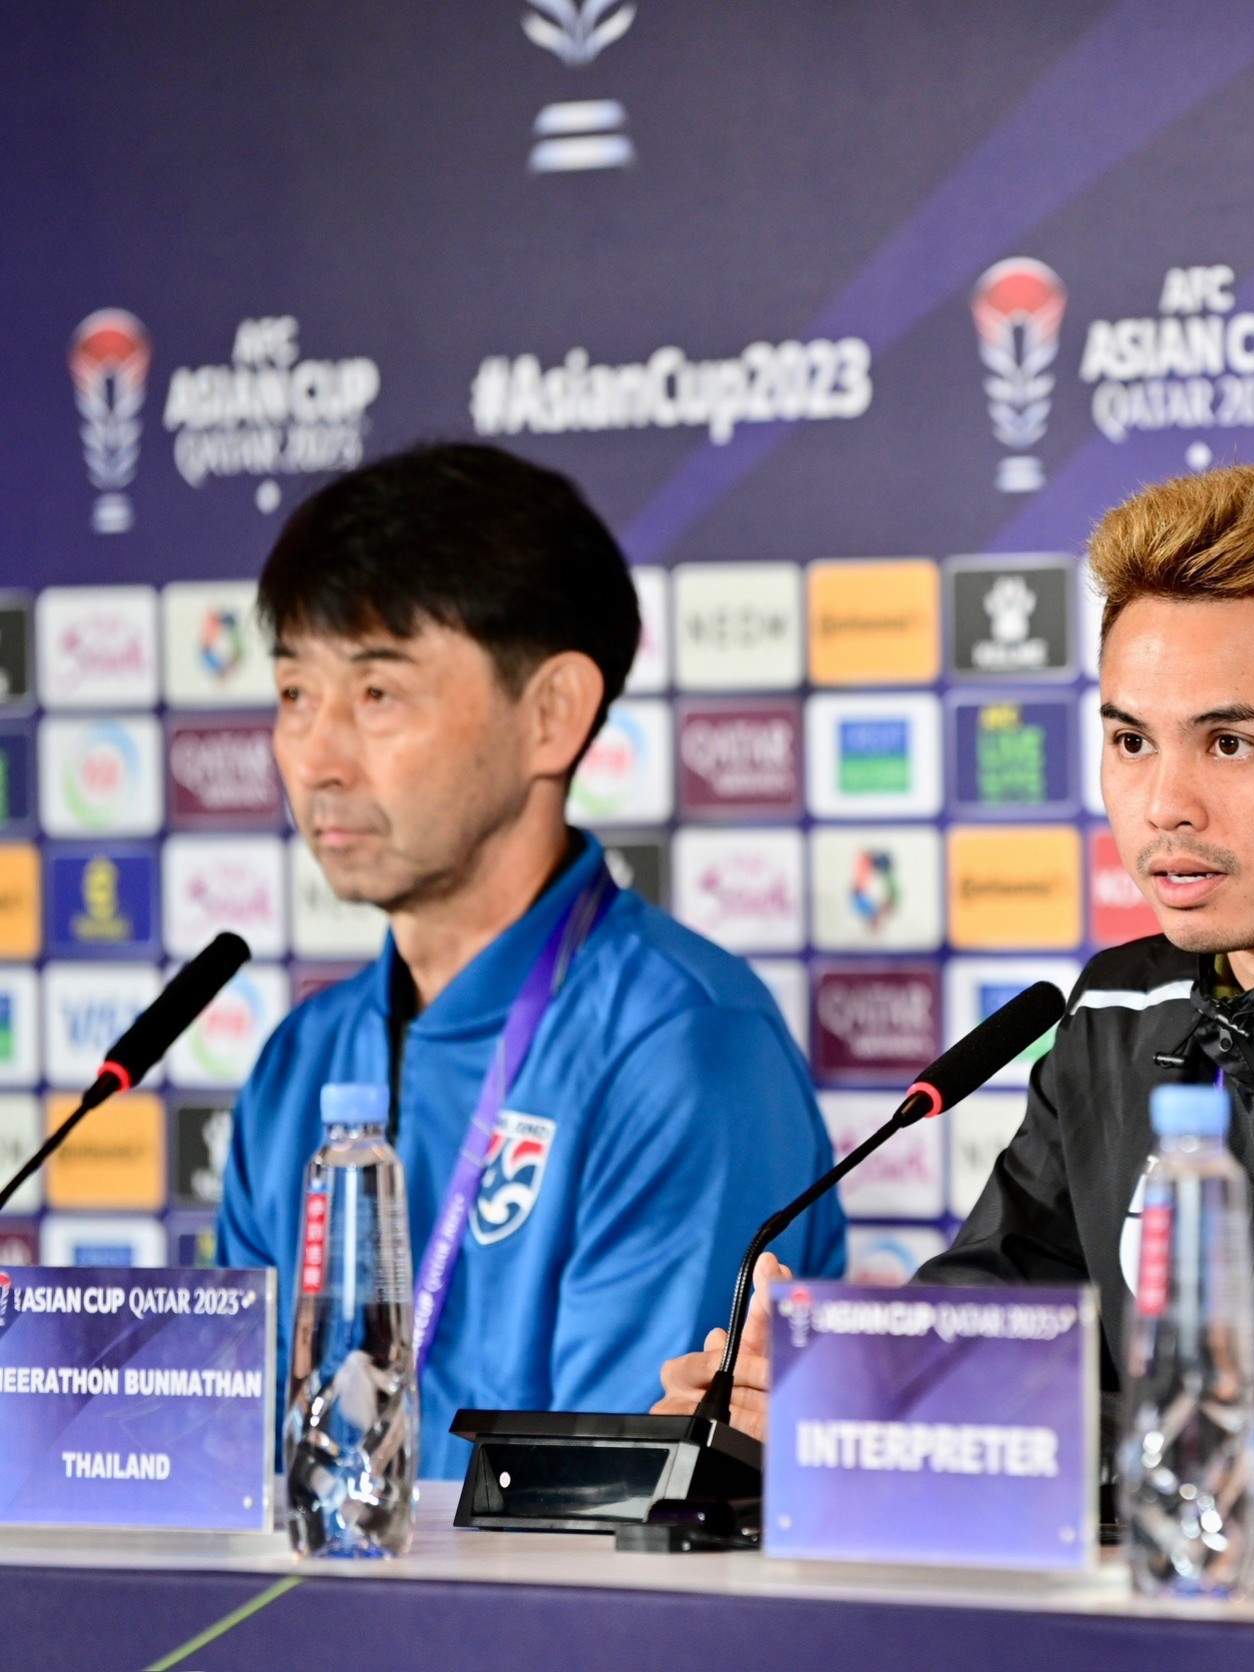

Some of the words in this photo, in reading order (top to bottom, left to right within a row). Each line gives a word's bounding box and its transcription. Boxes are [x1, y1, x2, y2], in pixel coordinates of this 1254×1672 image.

[1158, 264, 1236, 315] AFC
[1079, 314, 1226, 383] ASIAN
[470, 336, 874, 446] #AsianCup2023
[1091, 374, 1215, 444] QATAR
[22, 1287, 81, 1313] ASIAN
[83, 1287, 126, 1314] CUP
[129, 1287, 191, 1320] QATAR
[124, 1368, 263, 1398] BUNMATHAN
[62, 1451, 171, 1480] THAILAND
[796, 1420, 1059, 1477] INTERPRETER
